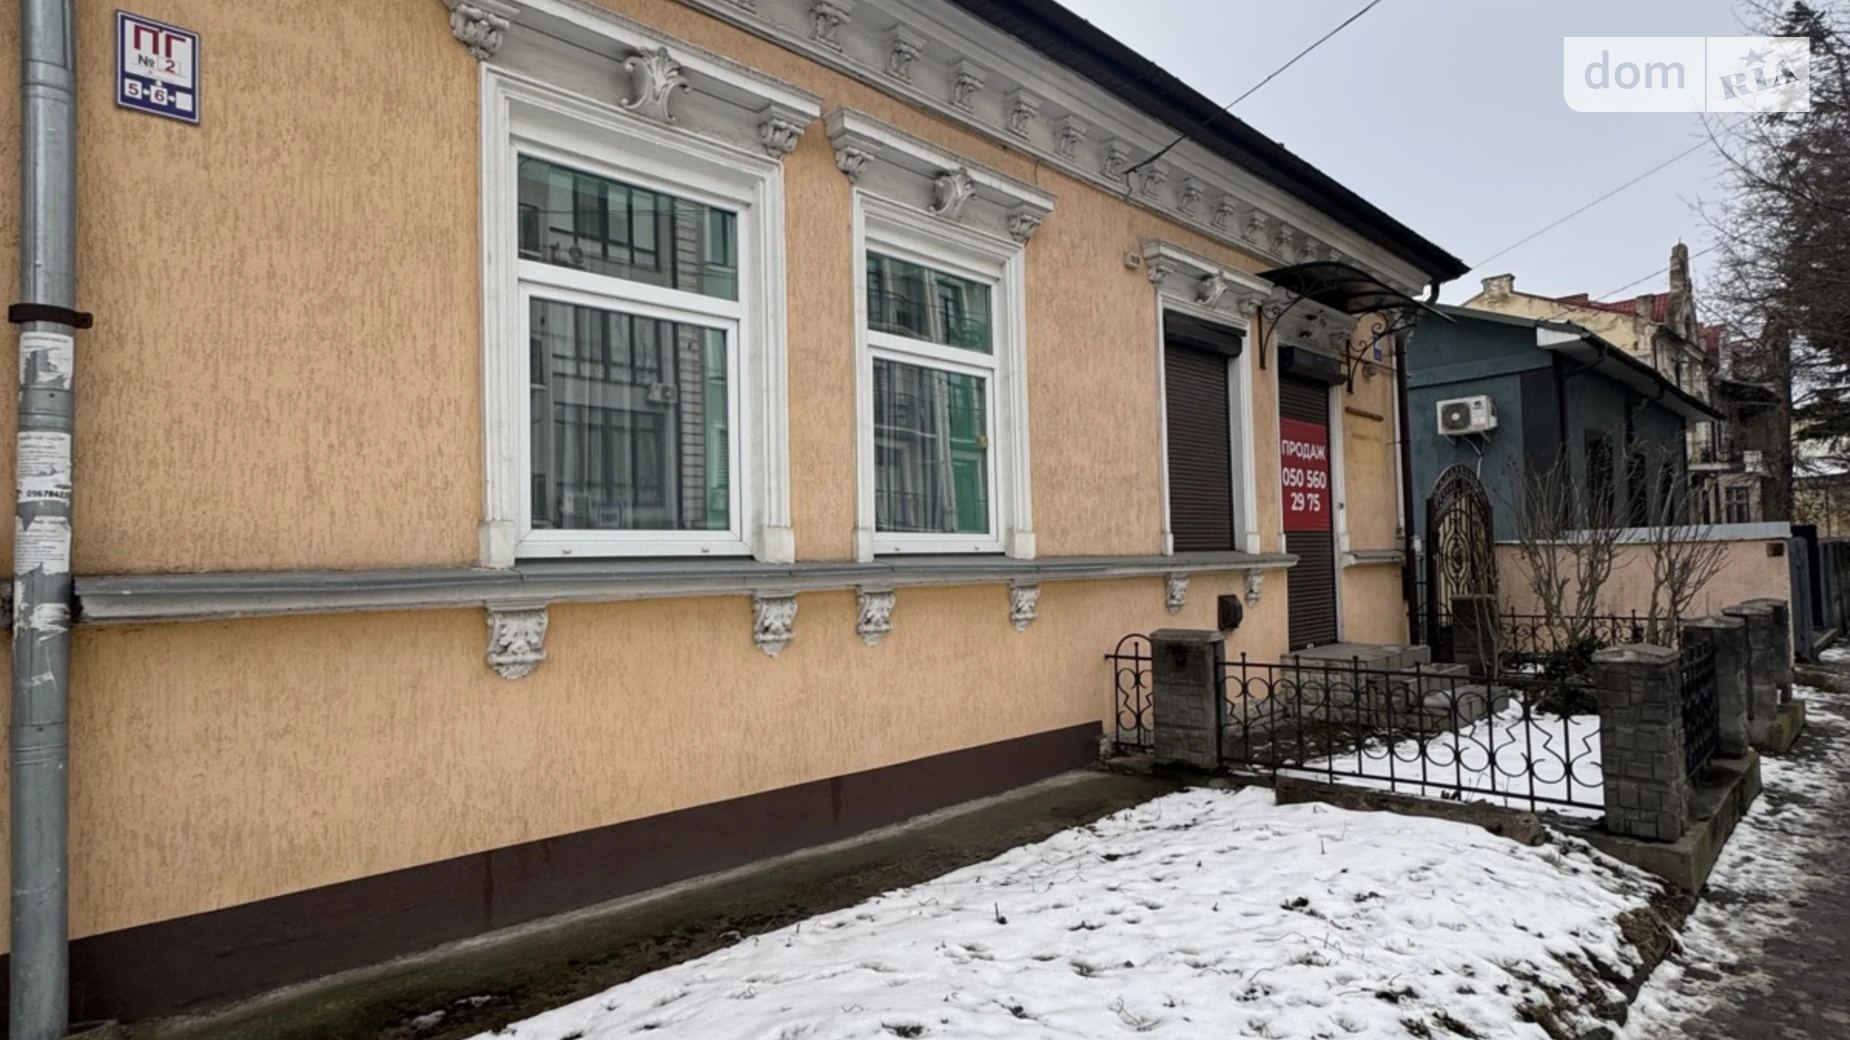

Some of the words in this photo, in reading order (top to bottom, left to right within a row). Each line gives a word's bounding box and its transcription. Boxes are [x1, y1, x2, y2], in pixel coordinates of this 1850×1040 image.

[134, 24, 187, 58] ПГ
[164, 59, 176, 74] 2
[128, 83, 139, 96] 5
[154, 89, 165, 102] 6
[1281, 439, 1327, 461] ПРОДАЖ
[1282, 467, 1304, 488] 050
[1306, 470, 1327, 489] 560
[1290, 492, 1305, 512] 29
[1306, 493, 1321, 512] 75
